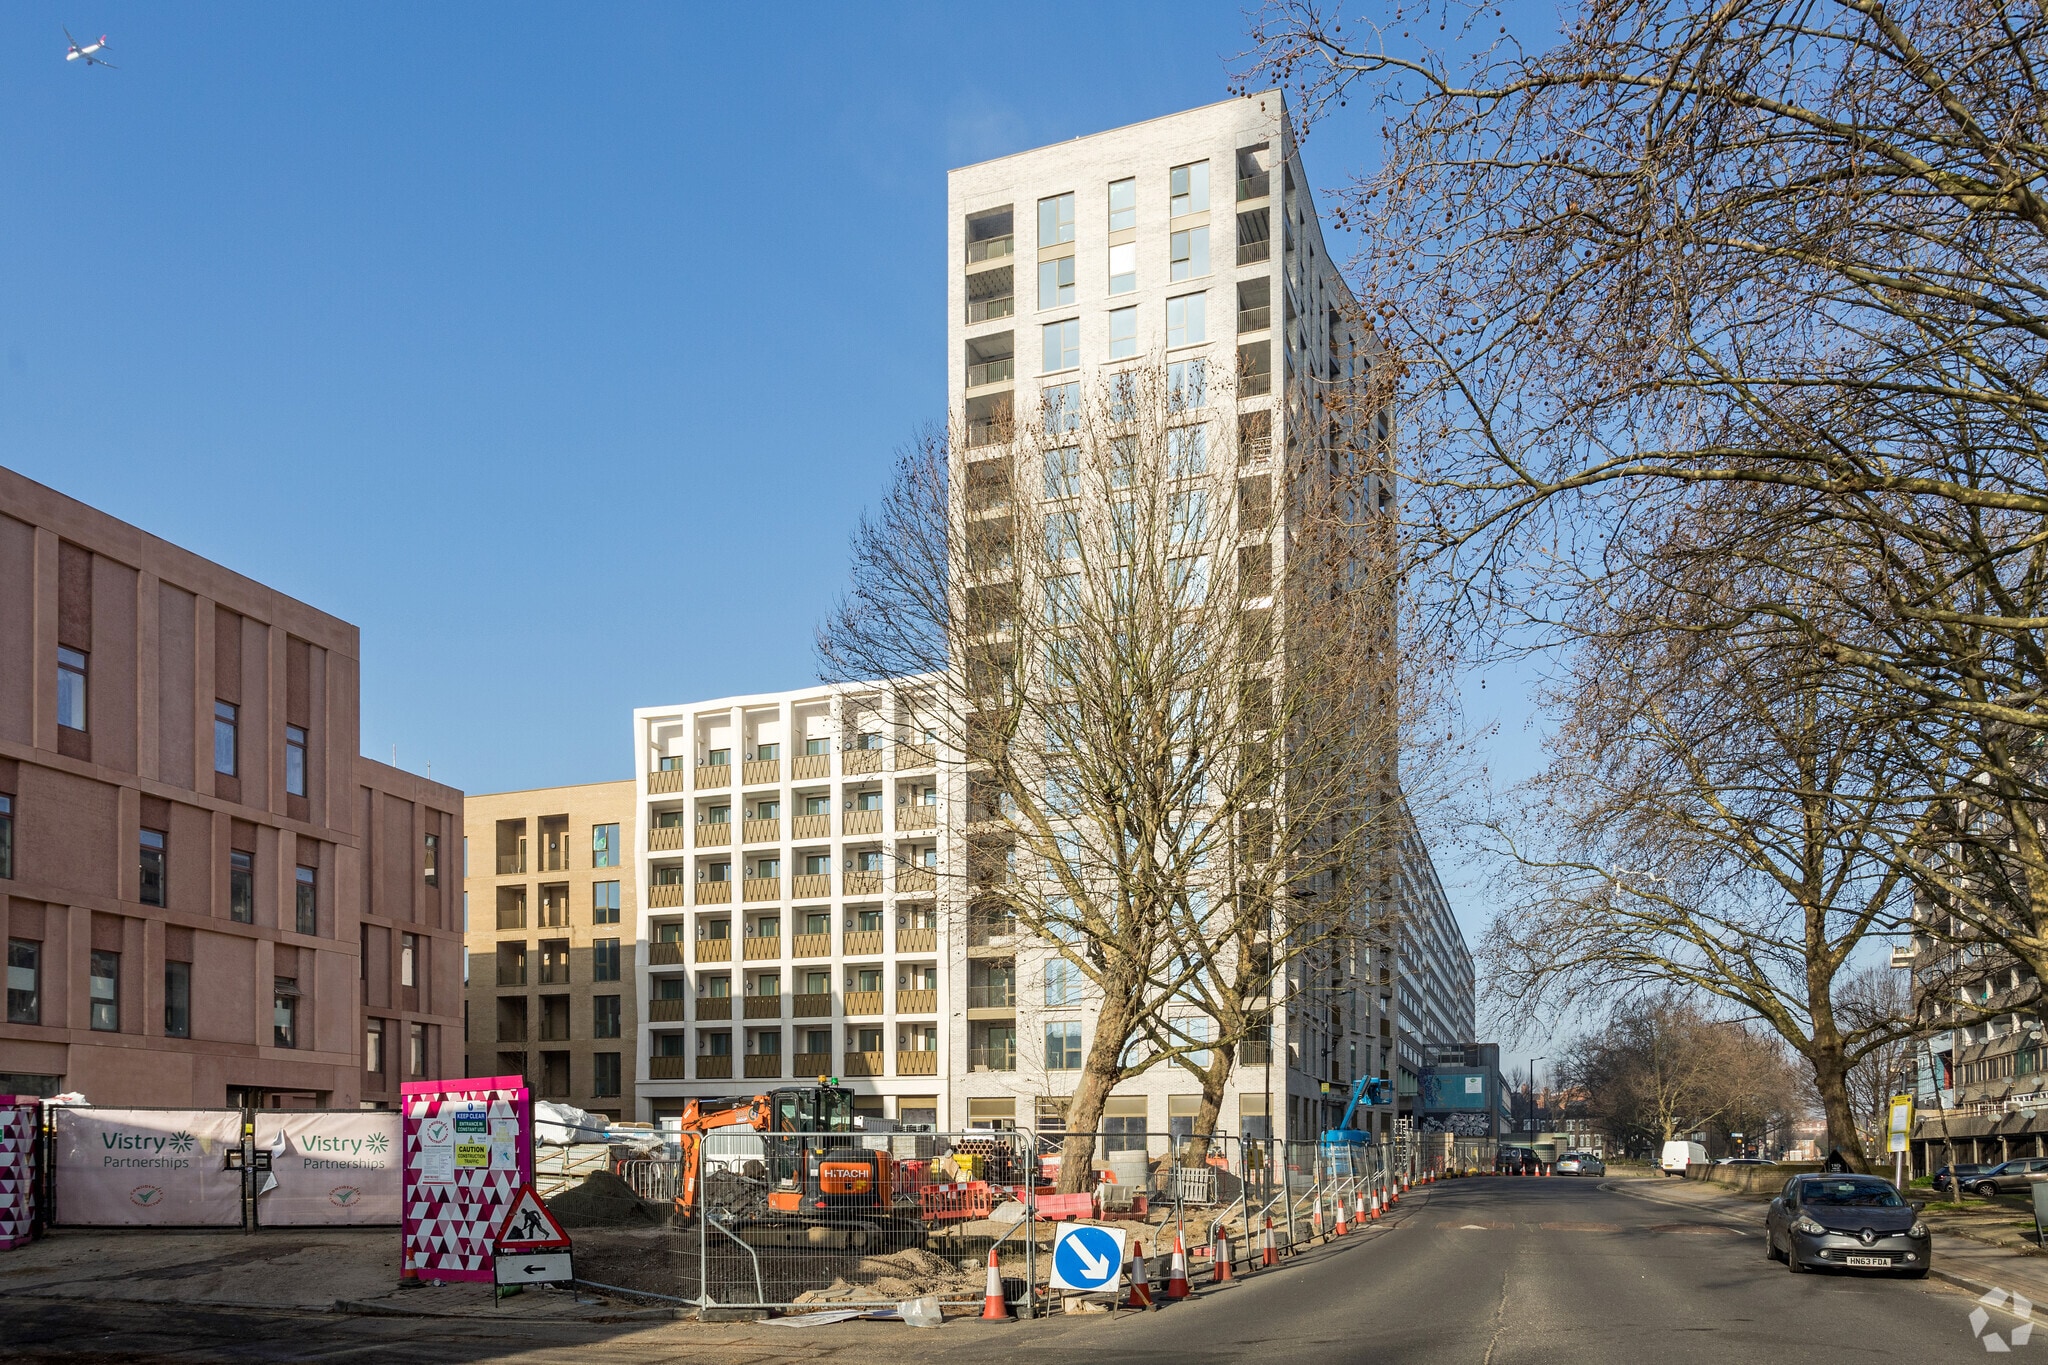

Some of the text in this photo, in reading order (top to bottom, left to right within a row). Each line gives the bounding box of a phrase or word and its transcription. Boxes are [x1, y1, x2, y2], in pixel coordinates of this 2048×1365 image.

[102, 1132, 166, 1154] Vistry
[301, 1135, 362, 1155] Vistry
[104, 1156, 189, 1170] Partnerships
[304, 1158, 385, 1171] Partnerships
[824, 1169, 869, 1178] HITACHI
[1872, 1258, 1888, 1266] FDA
